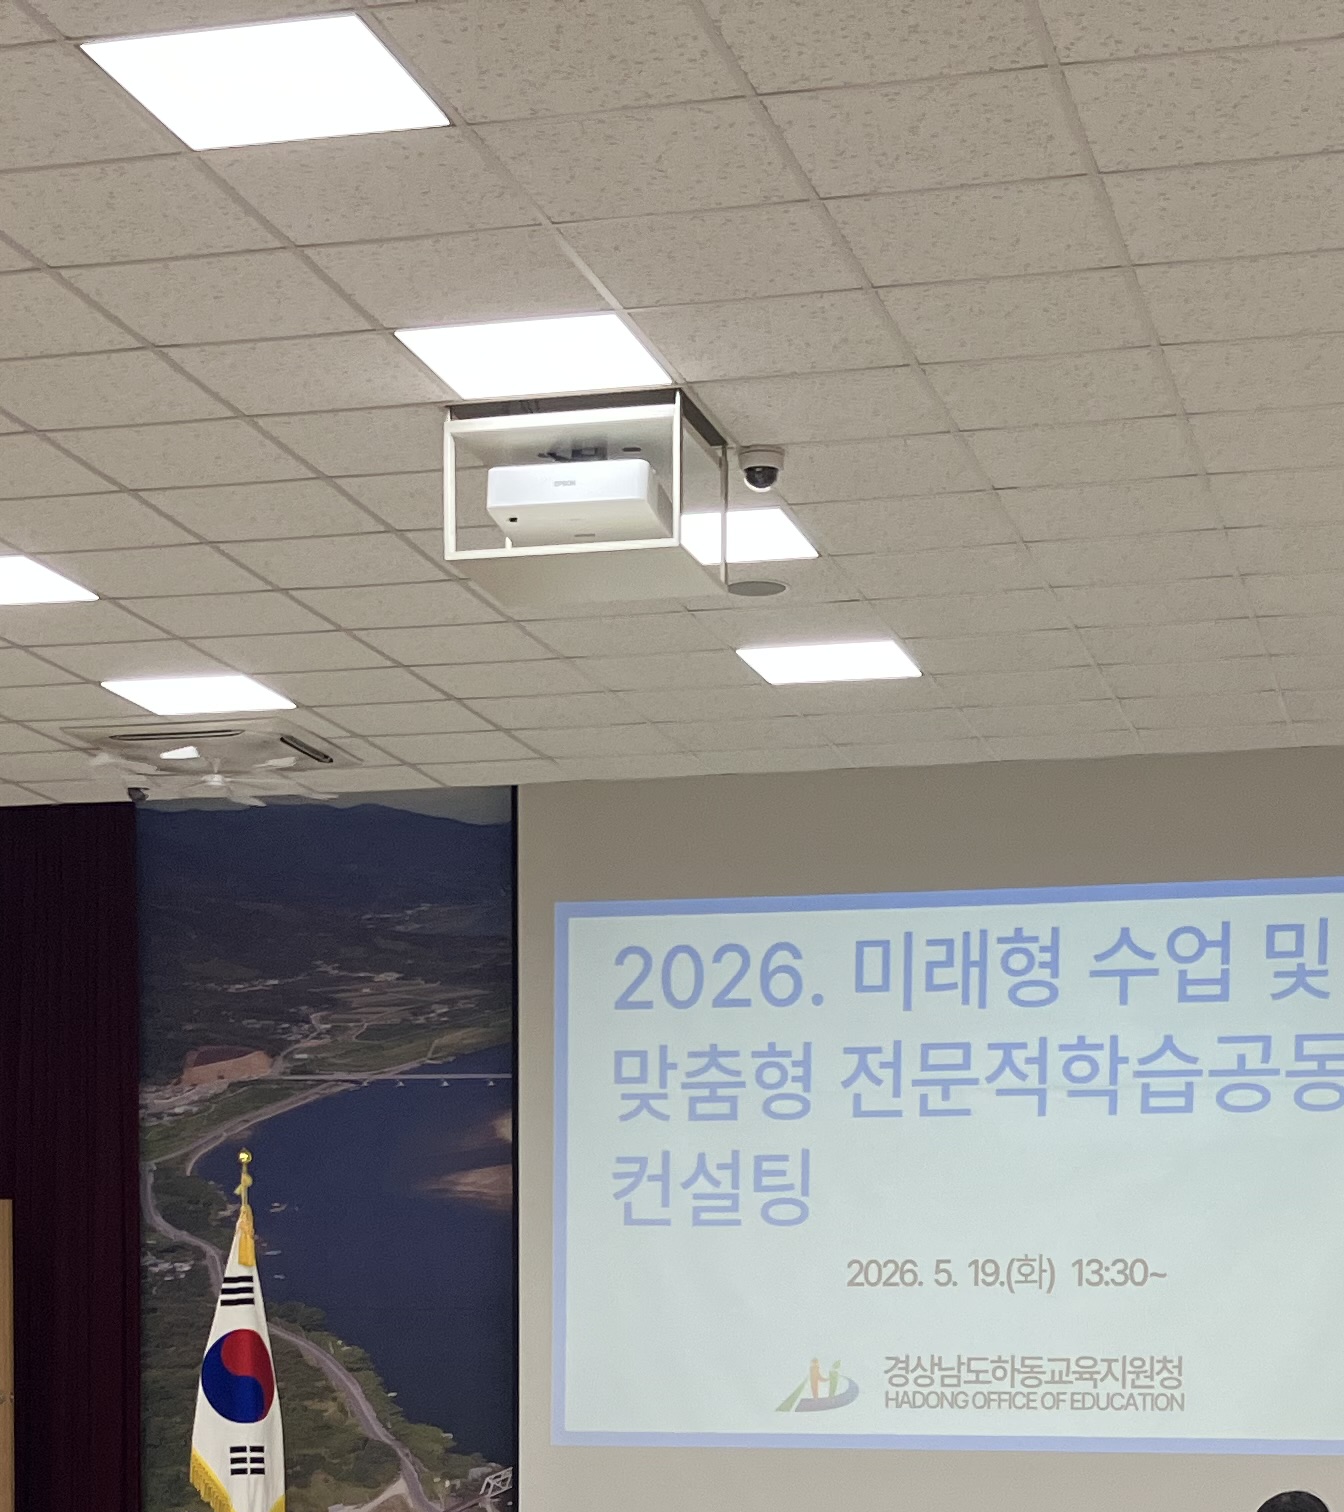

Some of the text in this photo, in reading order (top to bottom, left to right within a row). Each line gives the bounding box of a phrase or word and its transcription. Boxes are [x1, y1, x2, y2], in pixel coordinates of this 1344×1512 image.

[613, 916, 1332, 1013] 2026. 미래형 수업 및
[613, 1040, 813, 1123] 맞춤형
[611, 1147, 811, 1228] 컨설팅
[846, 1253, 1168, 1295] 2026. 5. 19.(화) 13:30~
[883, 1353, 1184, 1389] 경상남도하동교육지원청
[884, 1390, 1186, 1412] HADONG OFFICE OF EDUCATION
